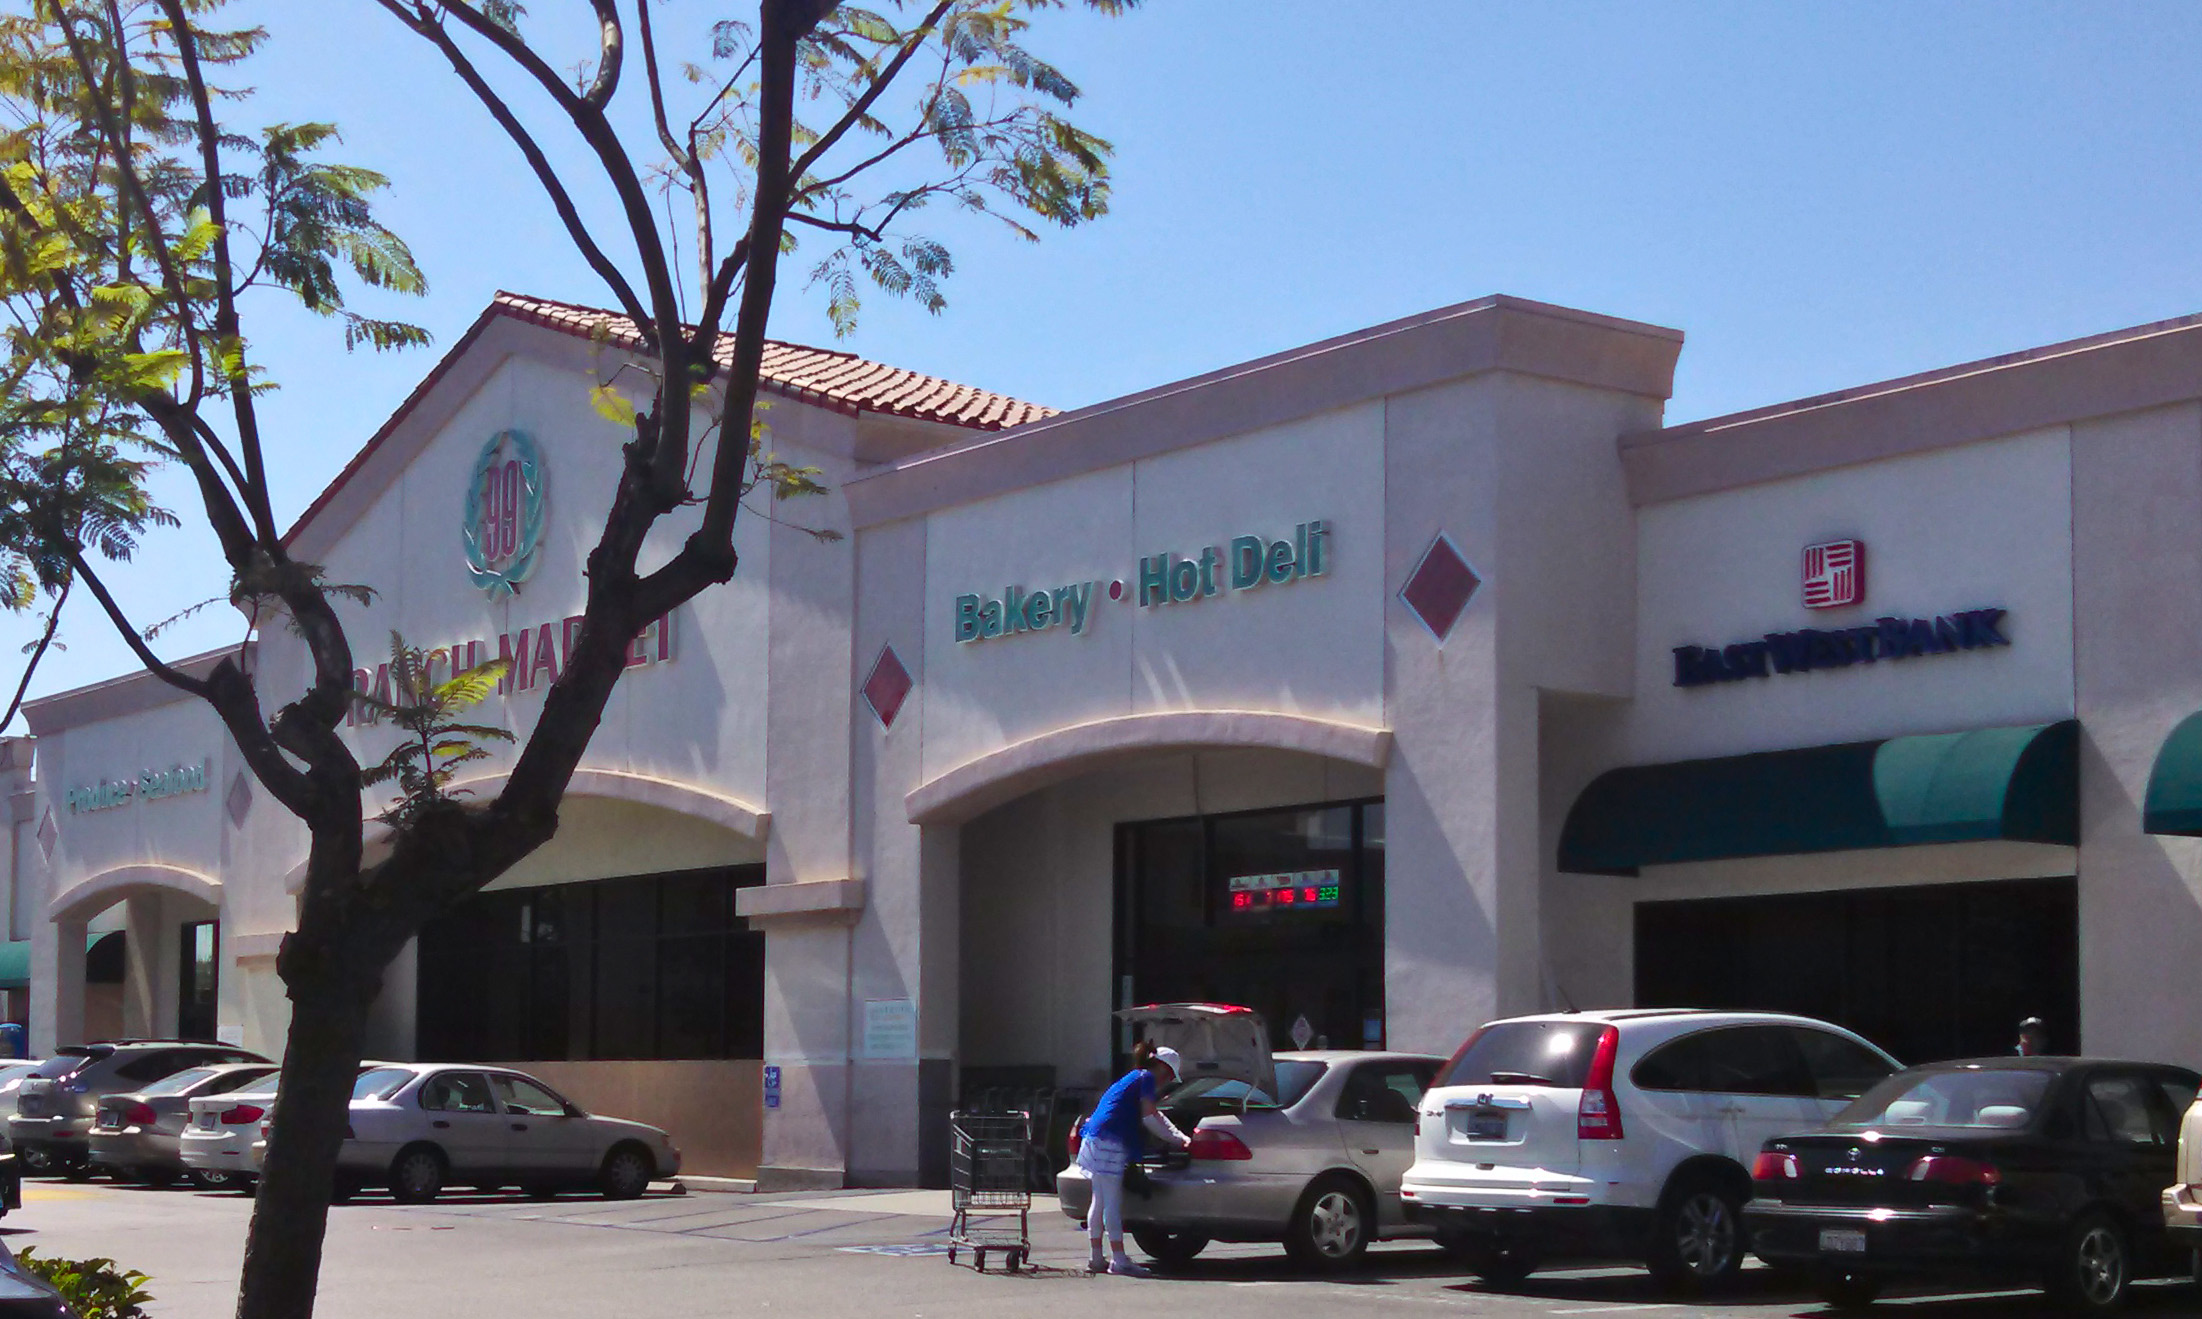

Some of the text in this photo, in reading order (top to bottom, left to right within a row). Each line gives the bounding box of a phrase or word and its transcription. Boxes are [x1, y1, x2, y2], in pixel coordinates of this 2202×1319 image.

[485, 460, 519, 562] 99
[955, 520, 1326, 644] Bakery Hot Deli
[497, 611, 676, 697] MAET
[1875, 608, 2011, 660] BANK
[138, 758, 206, 801] Seafood
